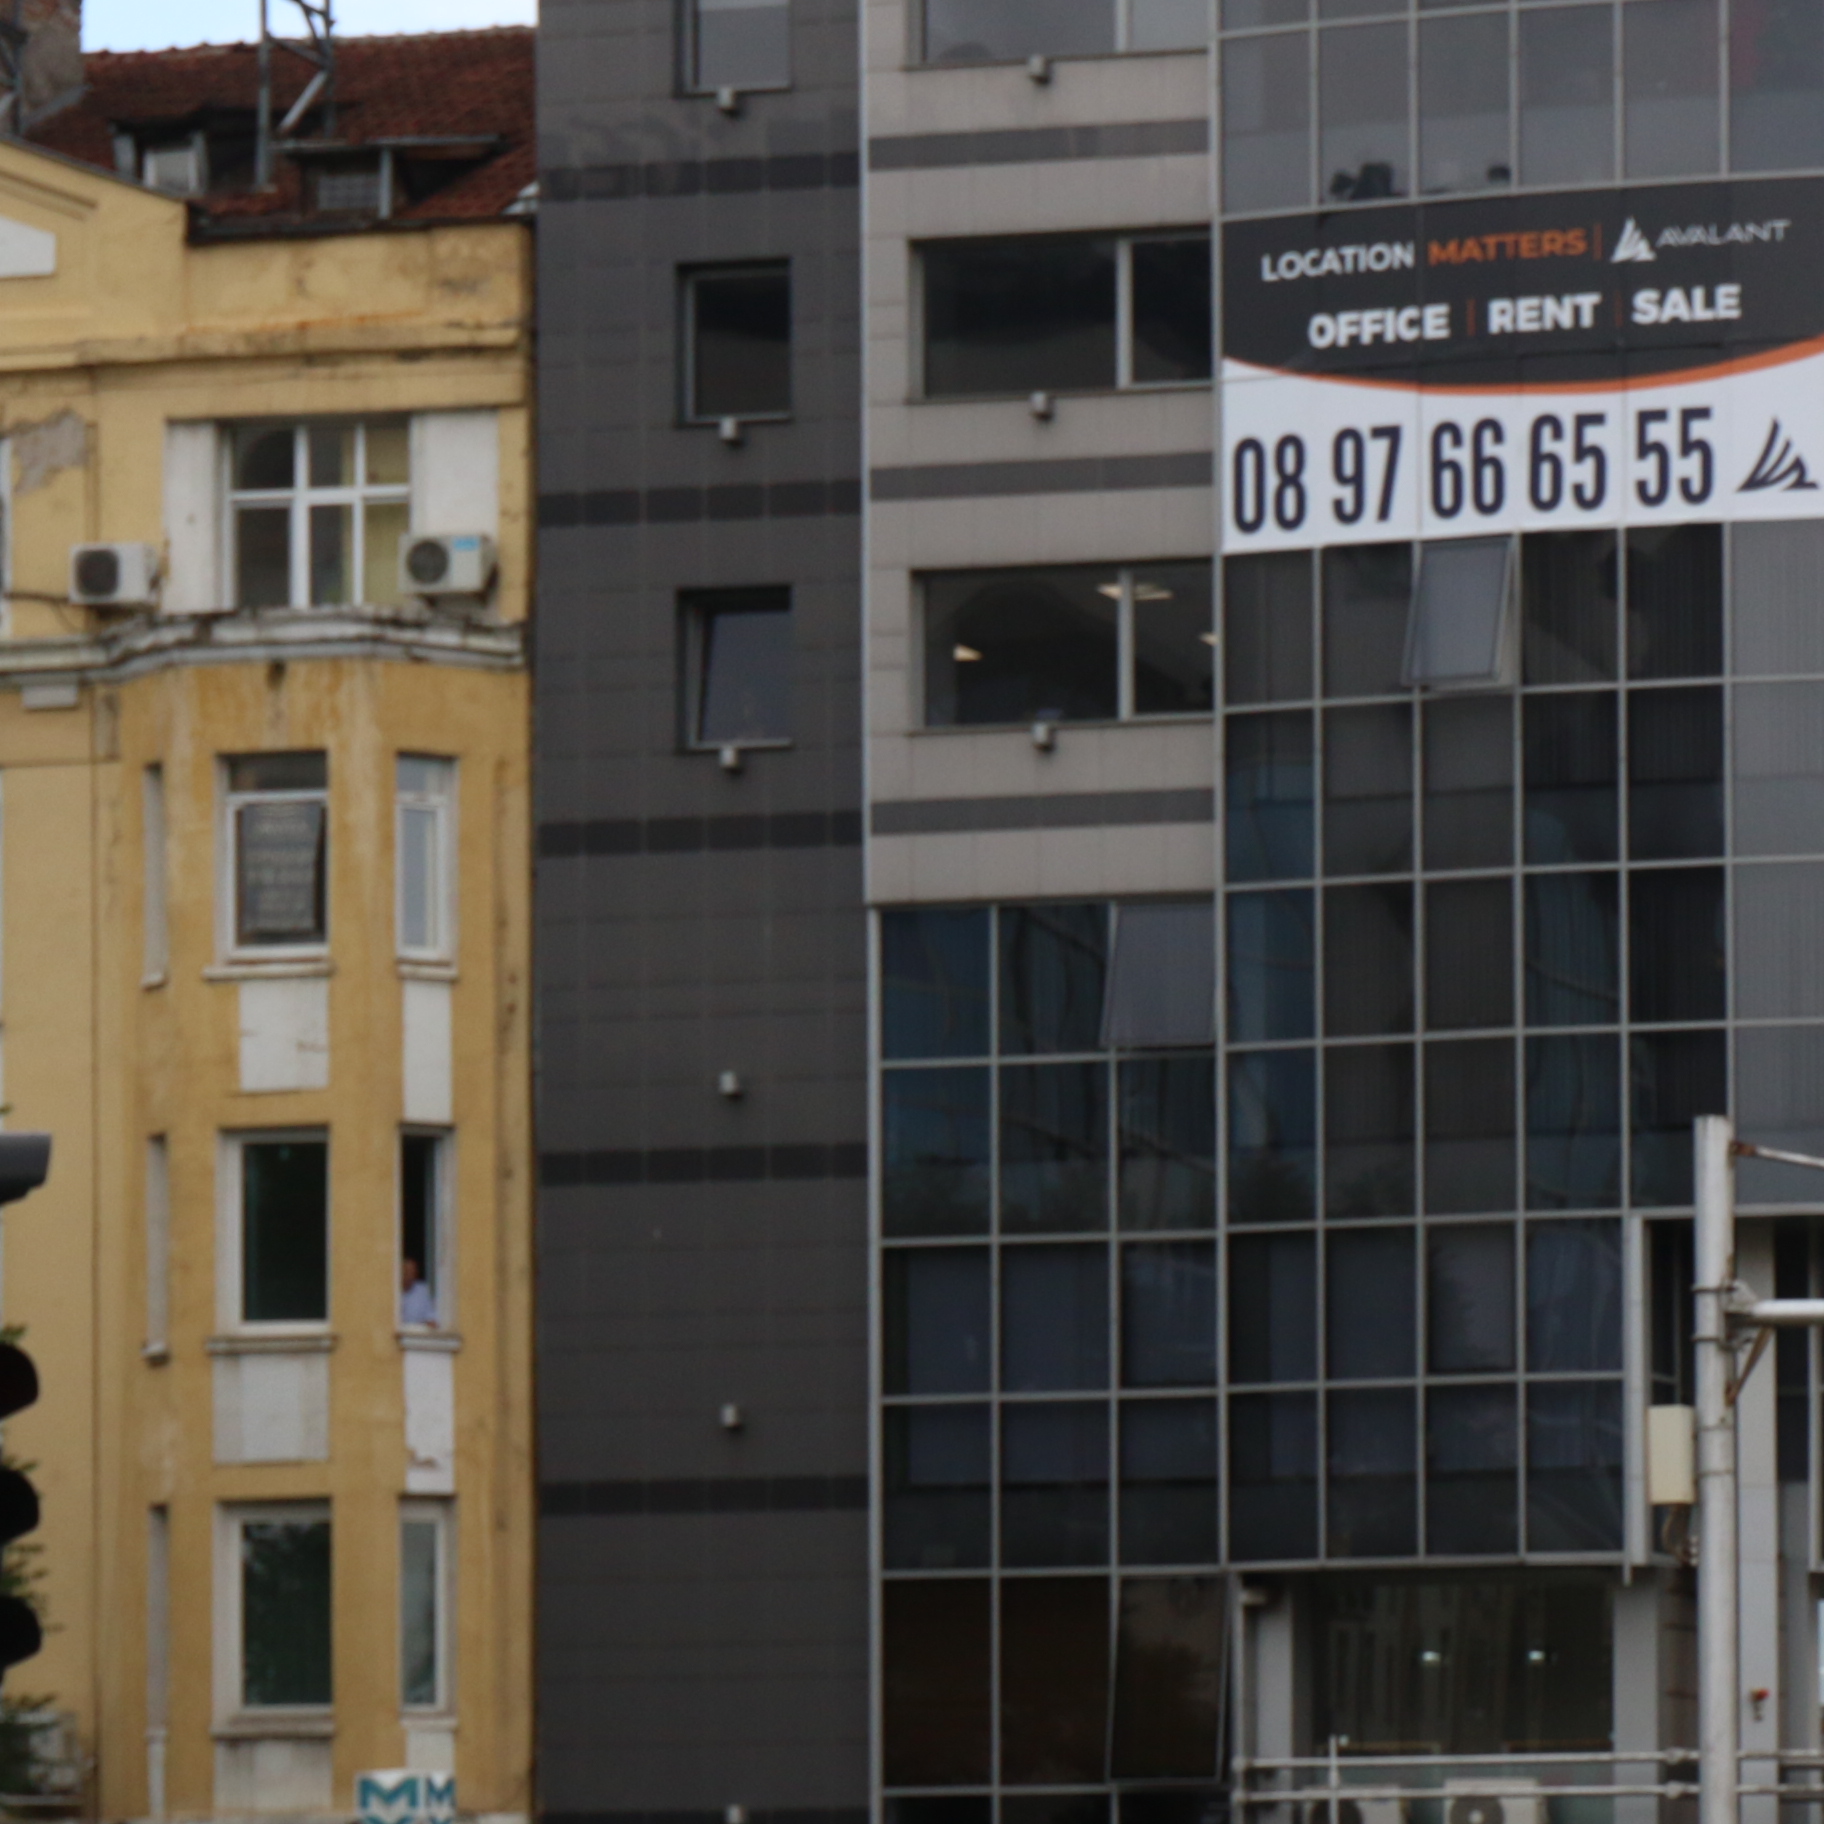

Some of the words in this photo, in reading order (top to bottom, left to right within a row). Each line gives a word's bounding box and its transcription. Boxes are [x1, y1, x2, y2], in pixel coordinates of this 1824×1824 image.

[1261, 241, 1415, 282] LOCATION
[1428, 228, 1587, 267] MATTERS
[1655, 218, 1791, 248] AVALANT
[1308, 304, 1450, 348] OFFICE
[1488, 292, 1602, 334] RENT
[1631, 283, 1742, 324] SALE
[1233, 434, 1307, 535] 08
[1332, 425, 1401, 526] 97
[1431, 418, 1506, 519] 66
[1529, 413, 1606, 512] 65
[1636, 407, 1714, 507] 55
